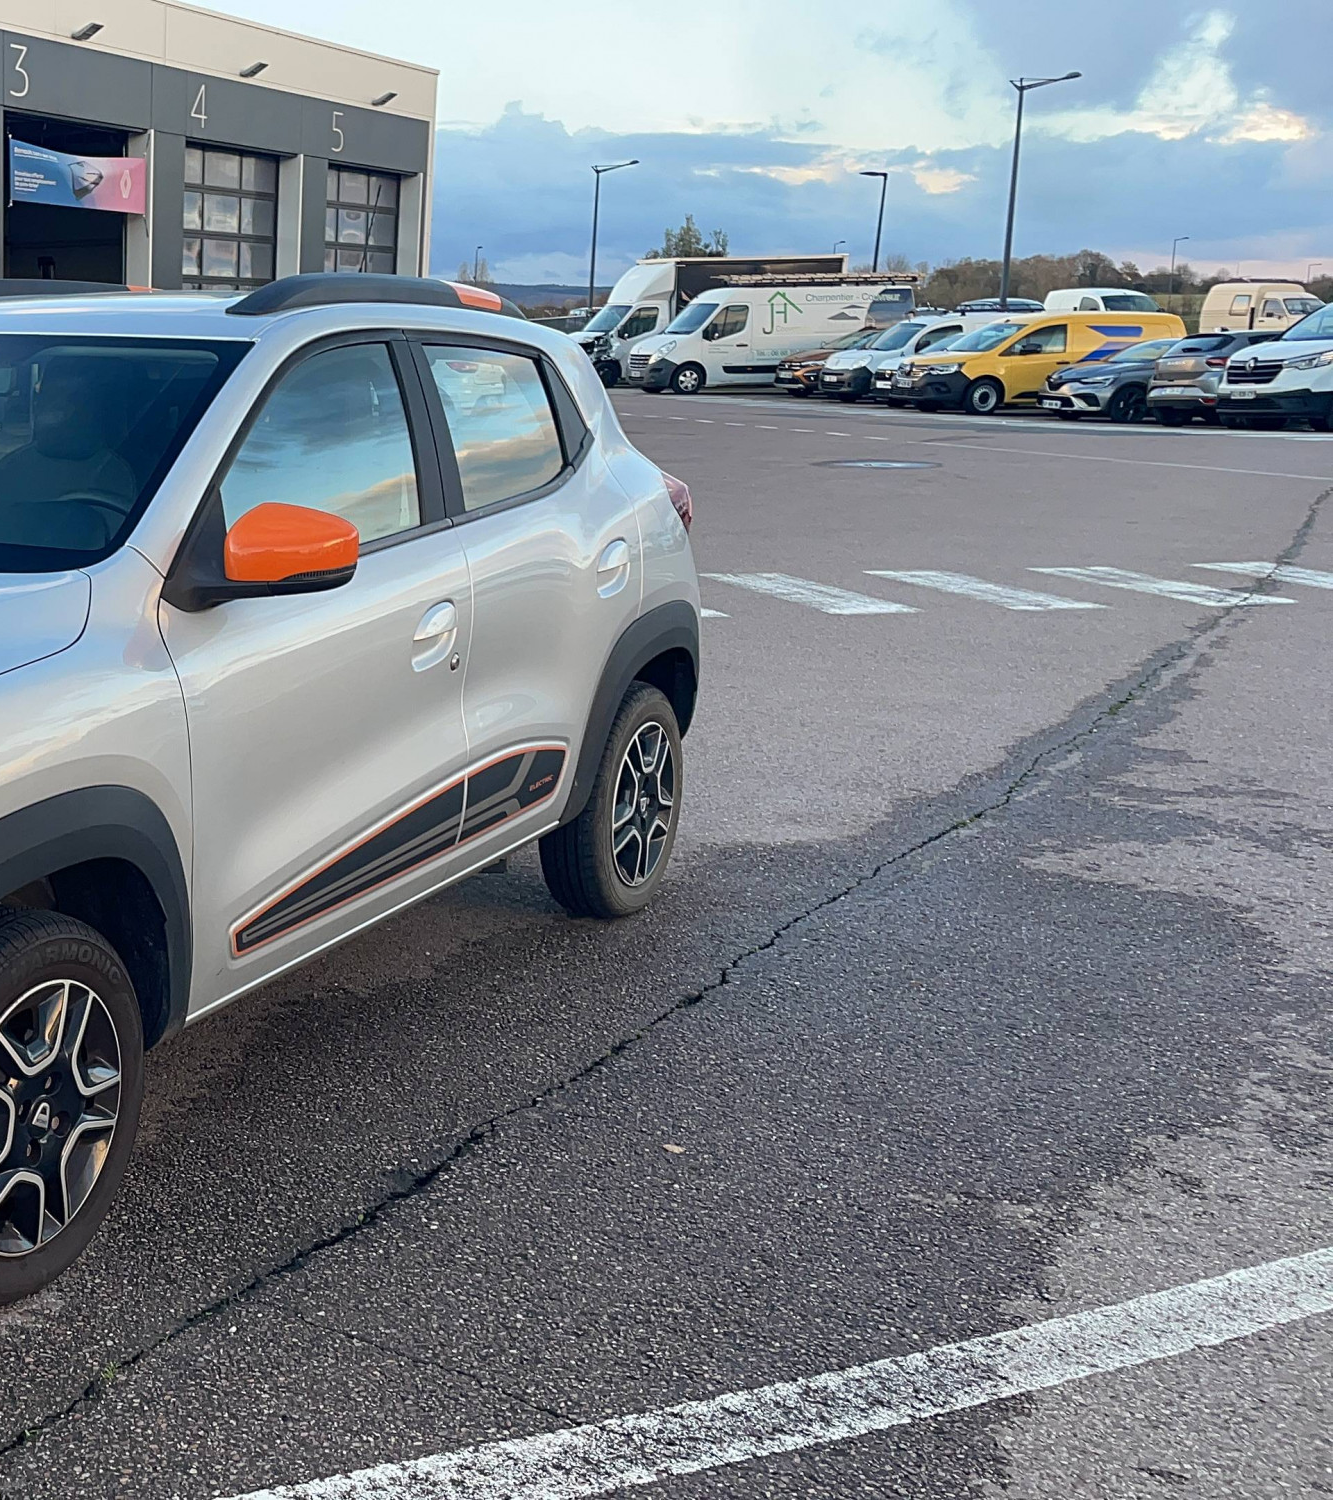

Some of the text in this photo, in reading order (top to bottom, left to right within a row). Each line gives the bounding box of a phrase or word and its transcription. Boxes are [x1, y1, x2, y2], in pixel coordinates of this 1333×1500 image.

[10, 43, 29, 97] 3
[190, 84, 208, 128] 4
[331, 111, 344, 152] 5
[805, 293, 854, 302] Charpentier
[529, 774, 554, 791] ELECTRIC
